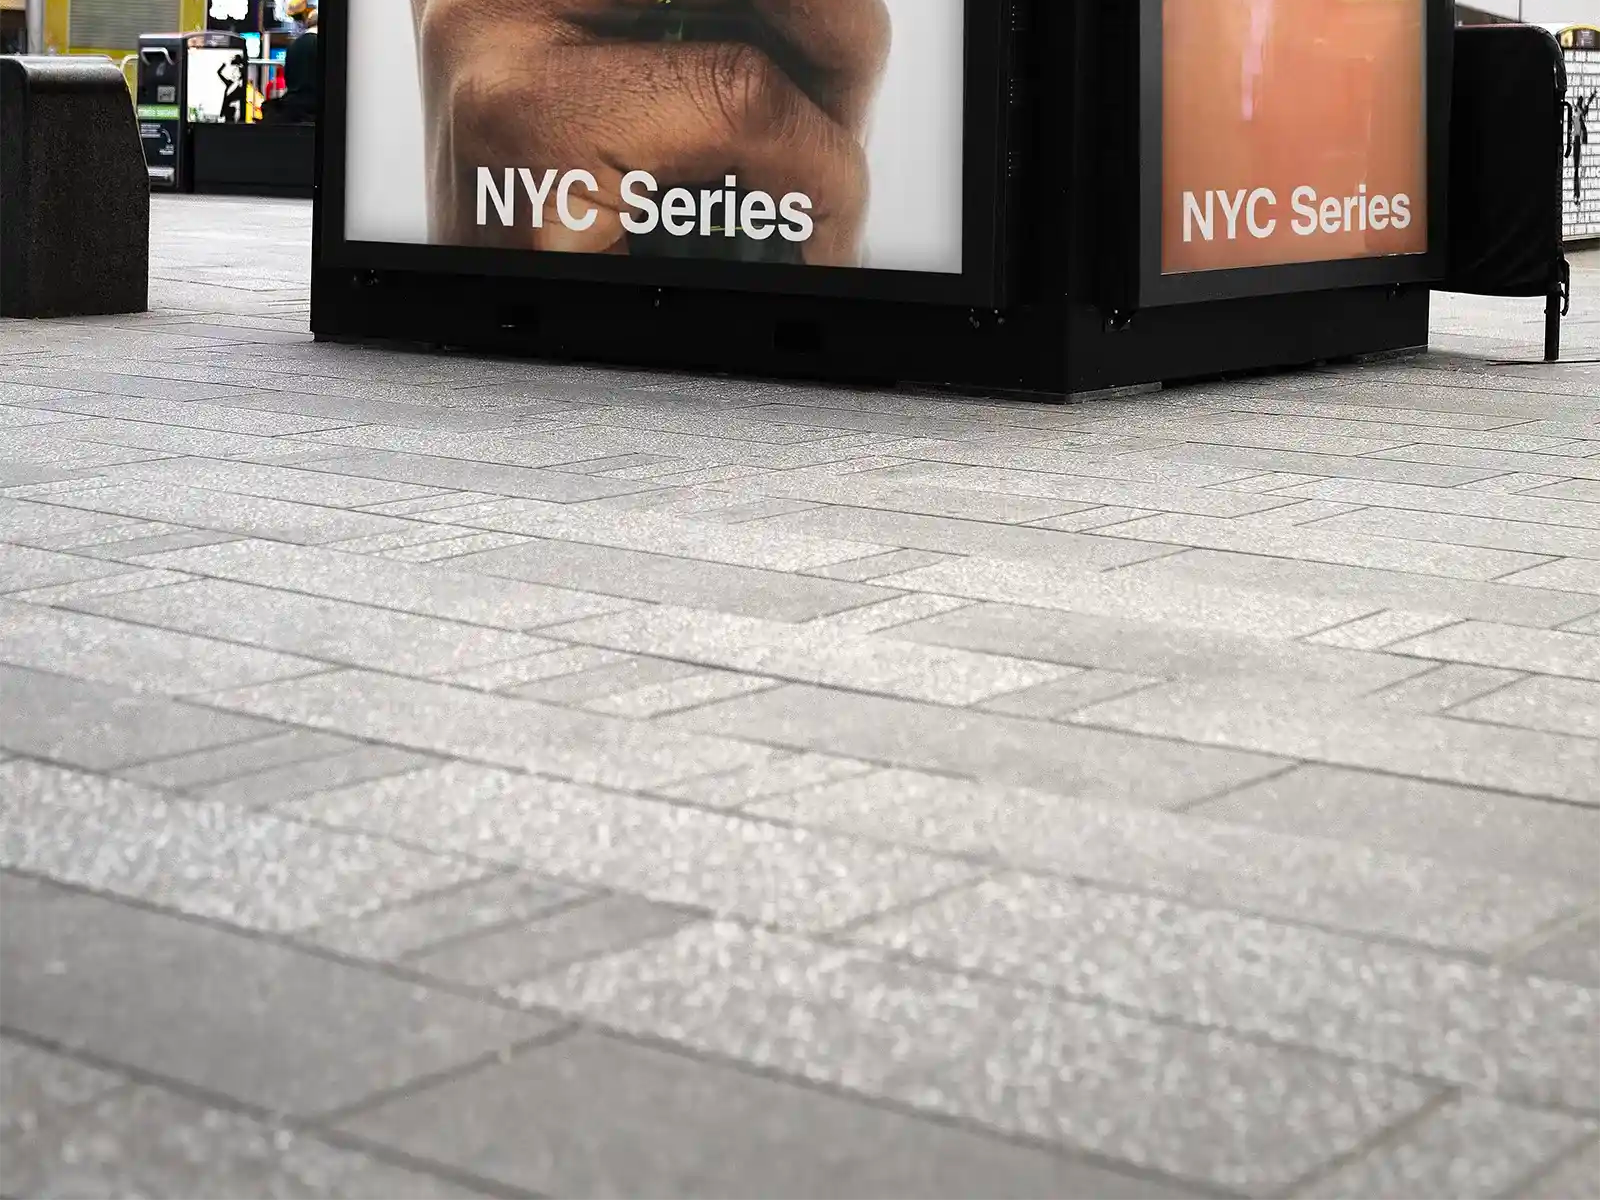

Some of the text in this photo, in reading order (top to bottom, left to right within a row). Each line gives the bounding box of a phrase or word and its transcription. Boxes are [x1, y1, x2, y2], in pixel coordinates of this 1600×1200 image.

[476, 166, 814, 242] NYC Series
[1183, 184, 1411, 242] NYC Series
